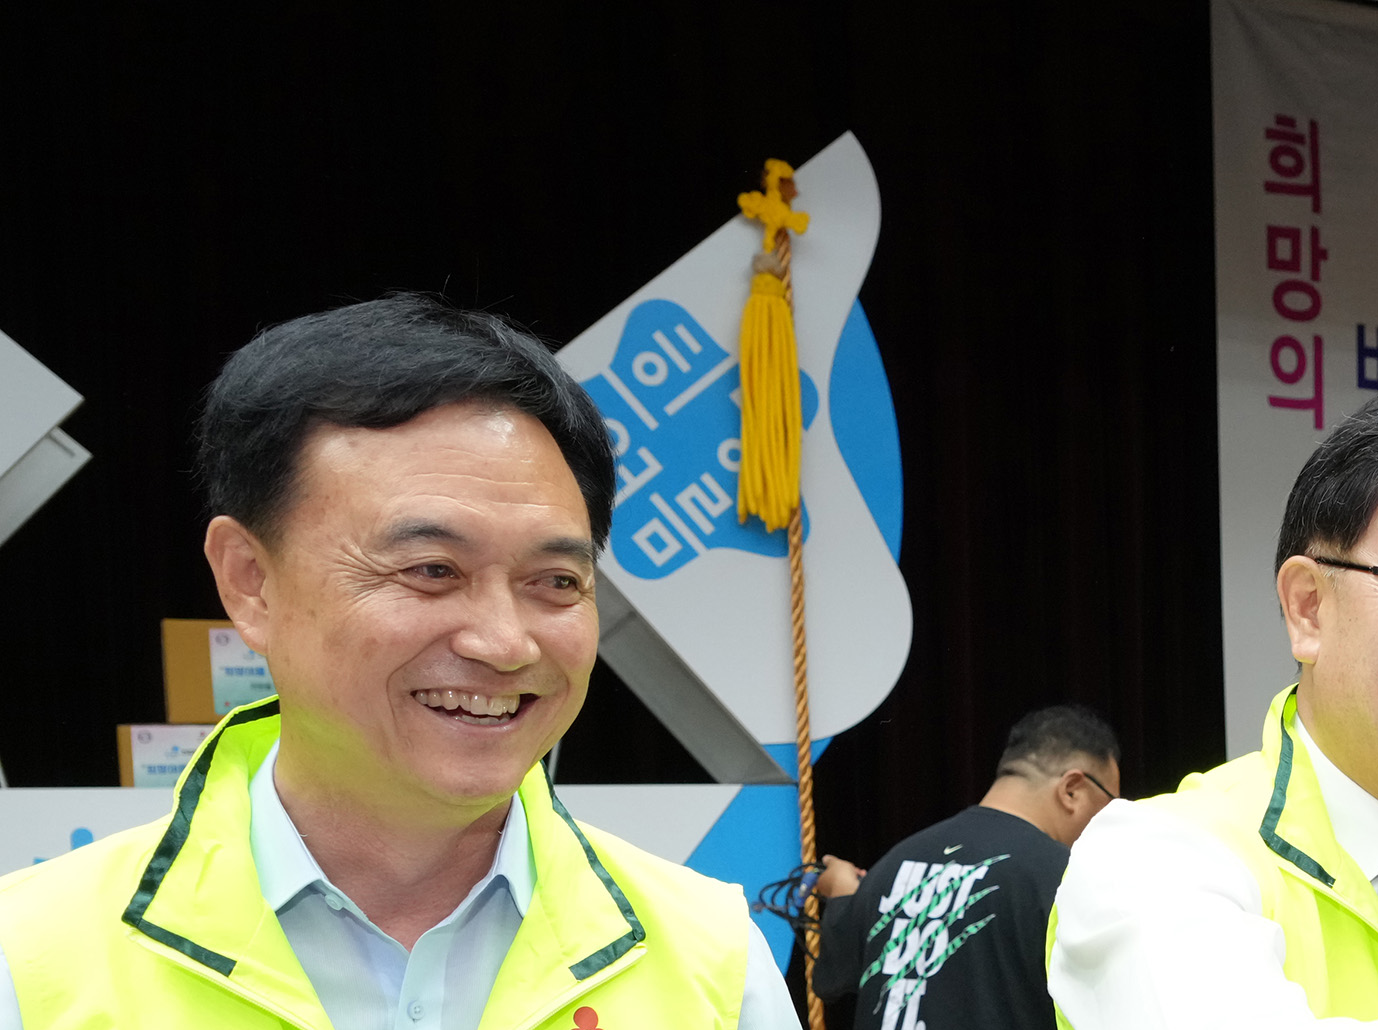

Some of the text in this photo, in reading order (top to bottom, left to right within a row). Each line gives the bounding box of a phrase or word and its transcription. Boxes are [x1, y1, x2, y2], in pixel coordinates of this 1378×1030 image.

[1264, 114, 1328, 430] 희망의
[878, 860, 989, 919] JUST
[882, 918, 949, 978] DO
